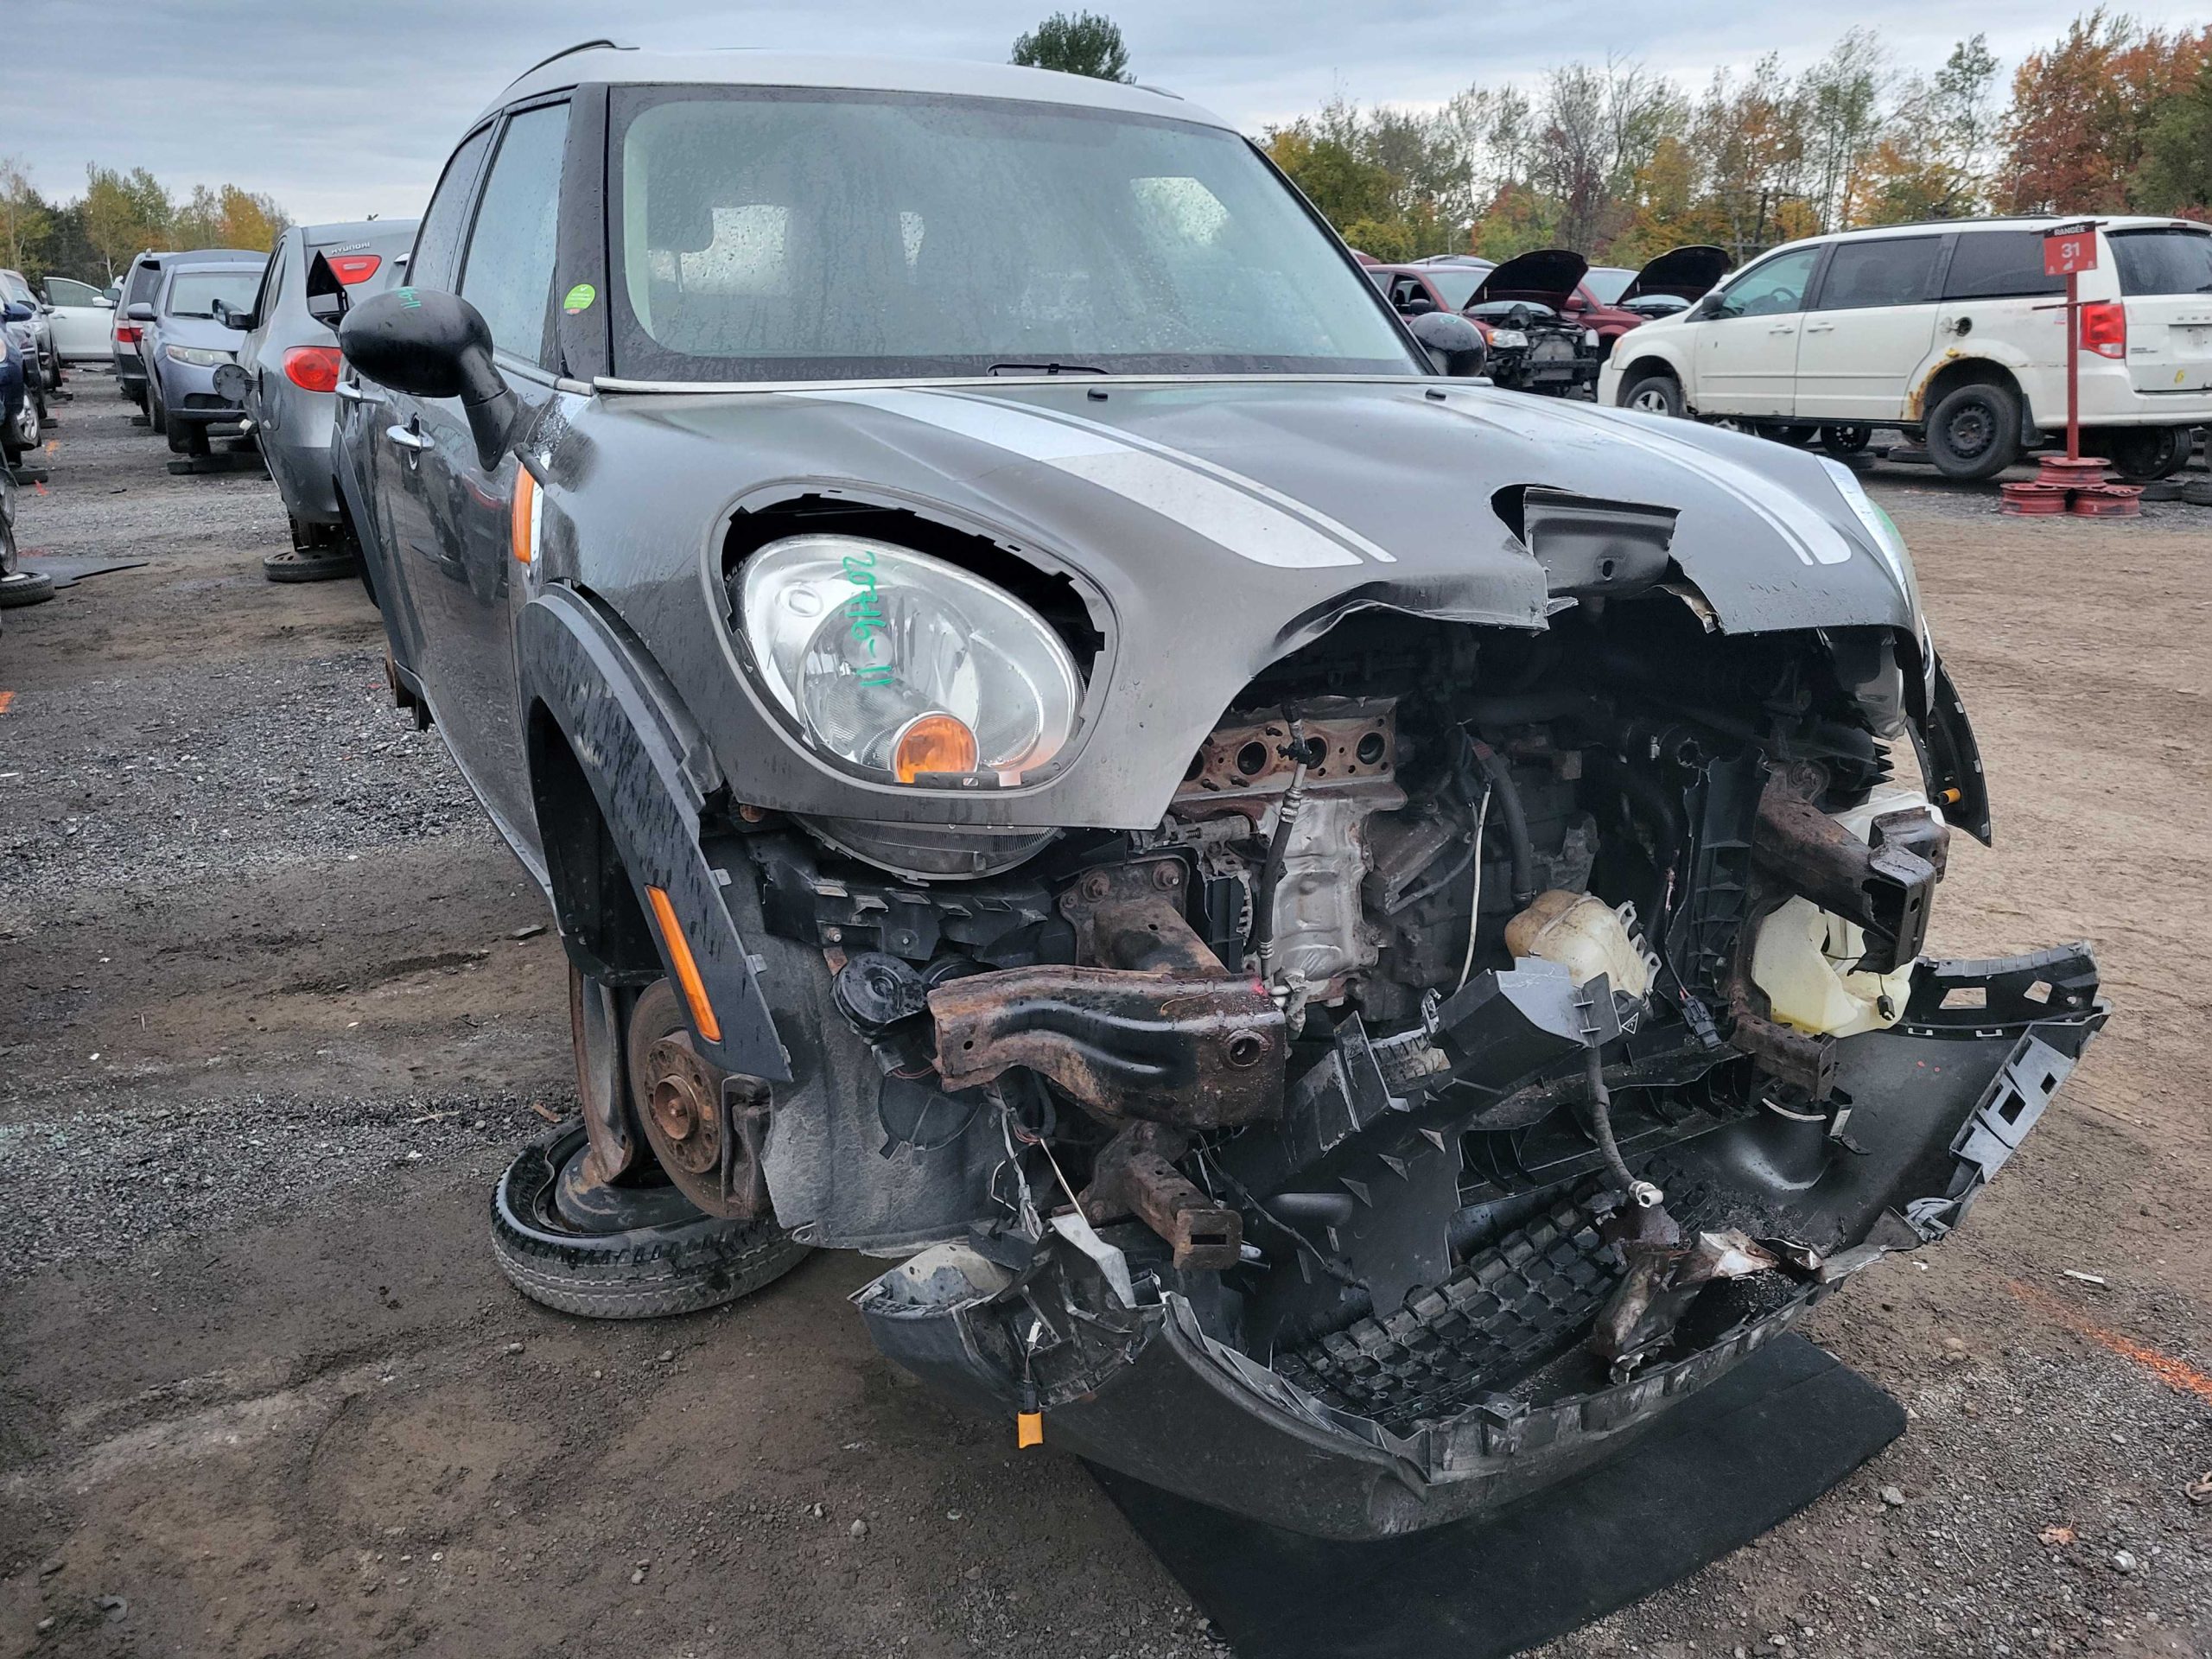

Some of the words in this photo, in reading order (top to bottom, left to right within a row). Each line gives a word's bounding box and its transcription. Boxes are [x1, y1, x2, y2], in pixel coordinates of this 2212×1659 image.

[2053, 224, 2086, 236] RANGÉE
[331, 241, 371, 255] HYUNDAI
[2061, 242, 2081, 258] 31
